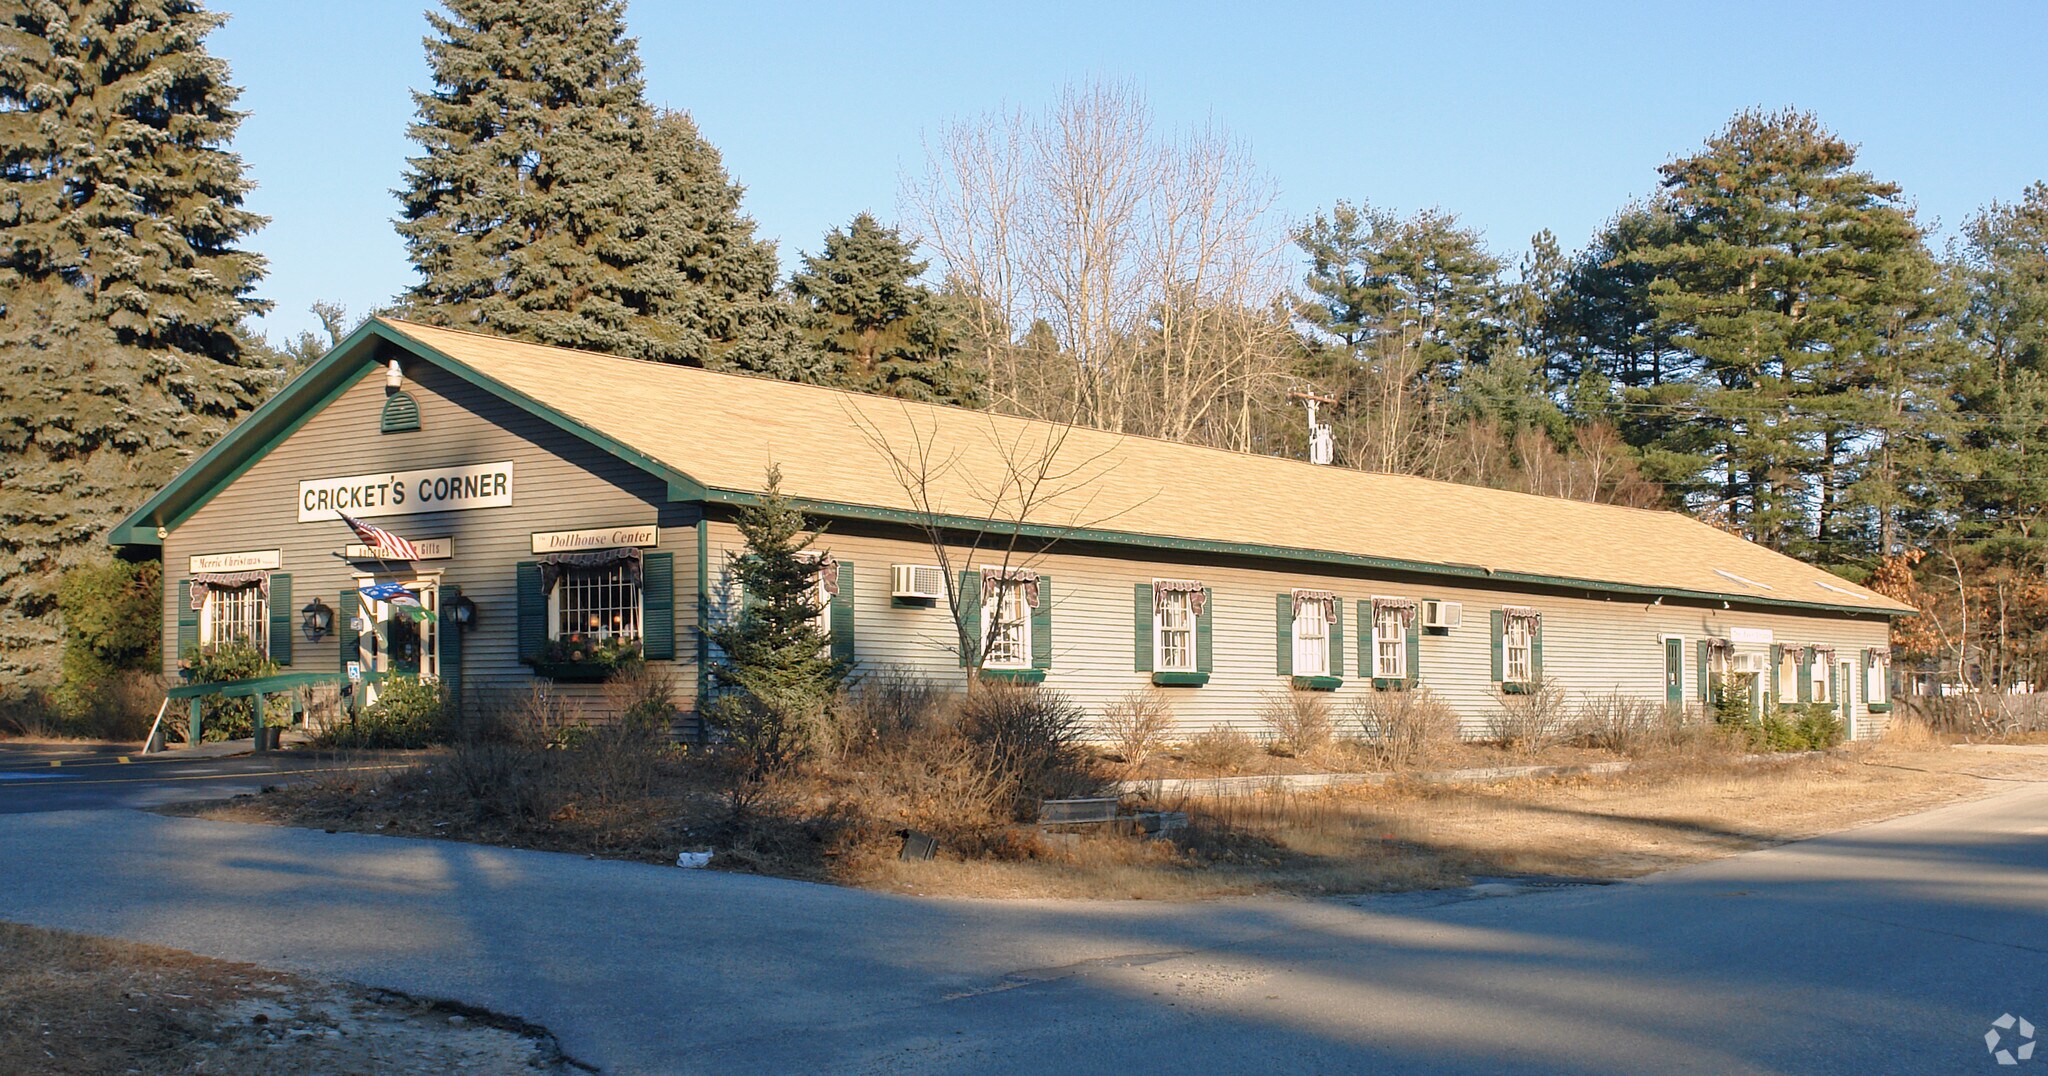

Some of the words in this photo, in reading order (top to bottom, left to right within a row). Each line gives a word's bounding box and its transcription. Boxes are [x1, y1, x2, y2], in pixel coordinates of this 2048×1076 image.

[304, 475, 405, 511] CRICKET'S
[418, 472, 507, 502] CORNER
[550, 533, 607, 548] Dollhouse
[612, 531, 652, 544] Center
[421, 543, 440, 555] Gifts
[224, 555, 261, 567] Christmas
